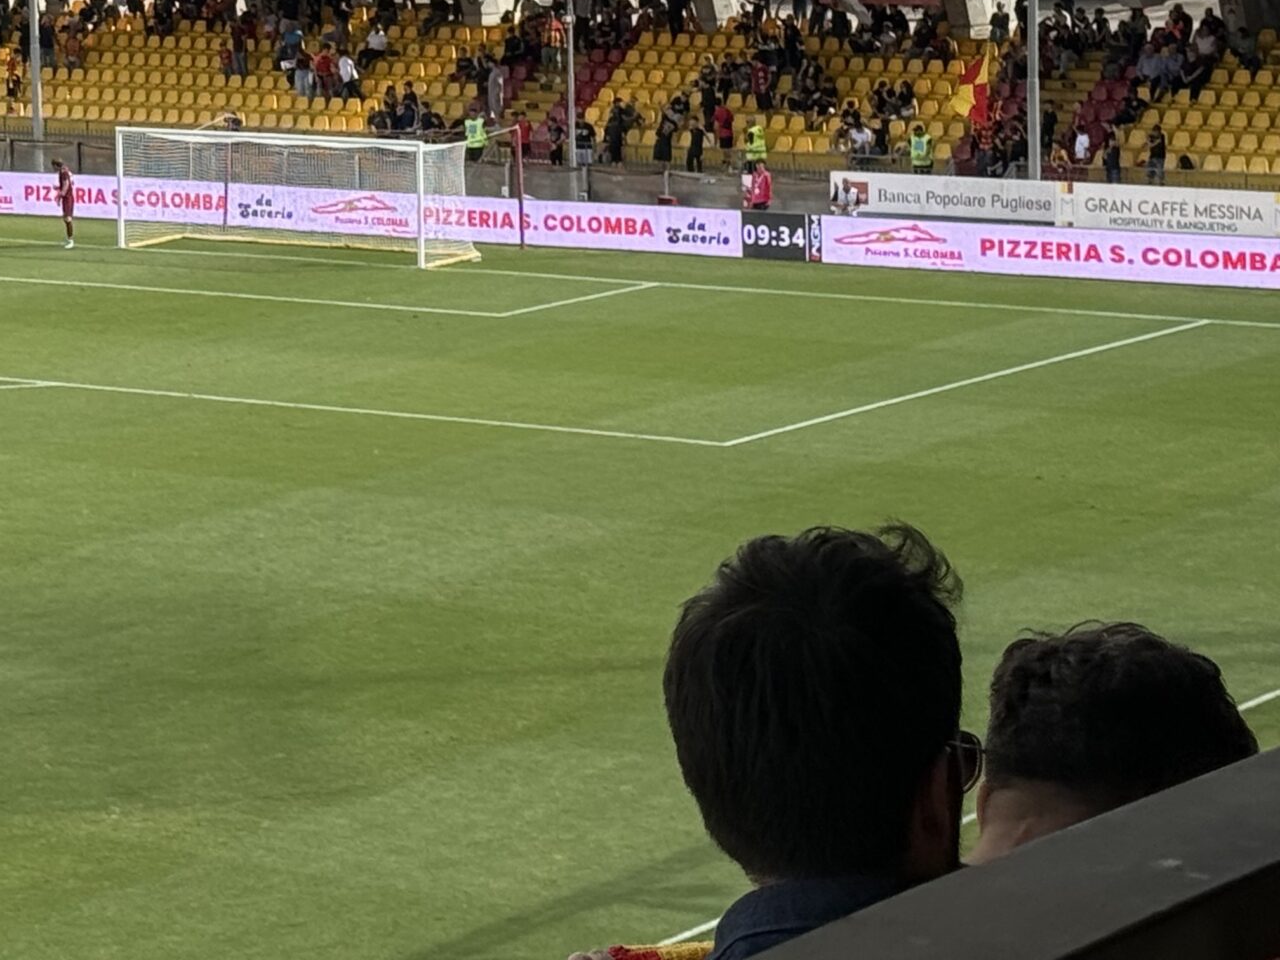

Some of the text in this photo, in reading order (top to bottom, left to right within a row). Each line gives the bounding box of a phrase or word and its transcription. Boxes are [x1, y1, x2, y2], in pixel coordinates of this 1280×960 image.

[24, 186, 107, 206] PIZRIA
[133, 191, 227, 211] COLOMBA
[255, 194, 272, 206] da
[877, 188, 1052, 214] Banca Popolare Pugliese
[1084, 196, 1264, 222] GRAN CAFFÈ MESSINA
[423, 207, 515, 229] PIZZERIA
[543, 214, 655, 237] COLOMBA
[687, 217, 706, 232] da
[1109, 216, 1164, 229] HOSPITALITY
[1167, 219, 1174, 229] &
[743, 224, 805, 246] 09:34
[980, 238, 1280, 273] PIZZERIA S. COLOMBA
